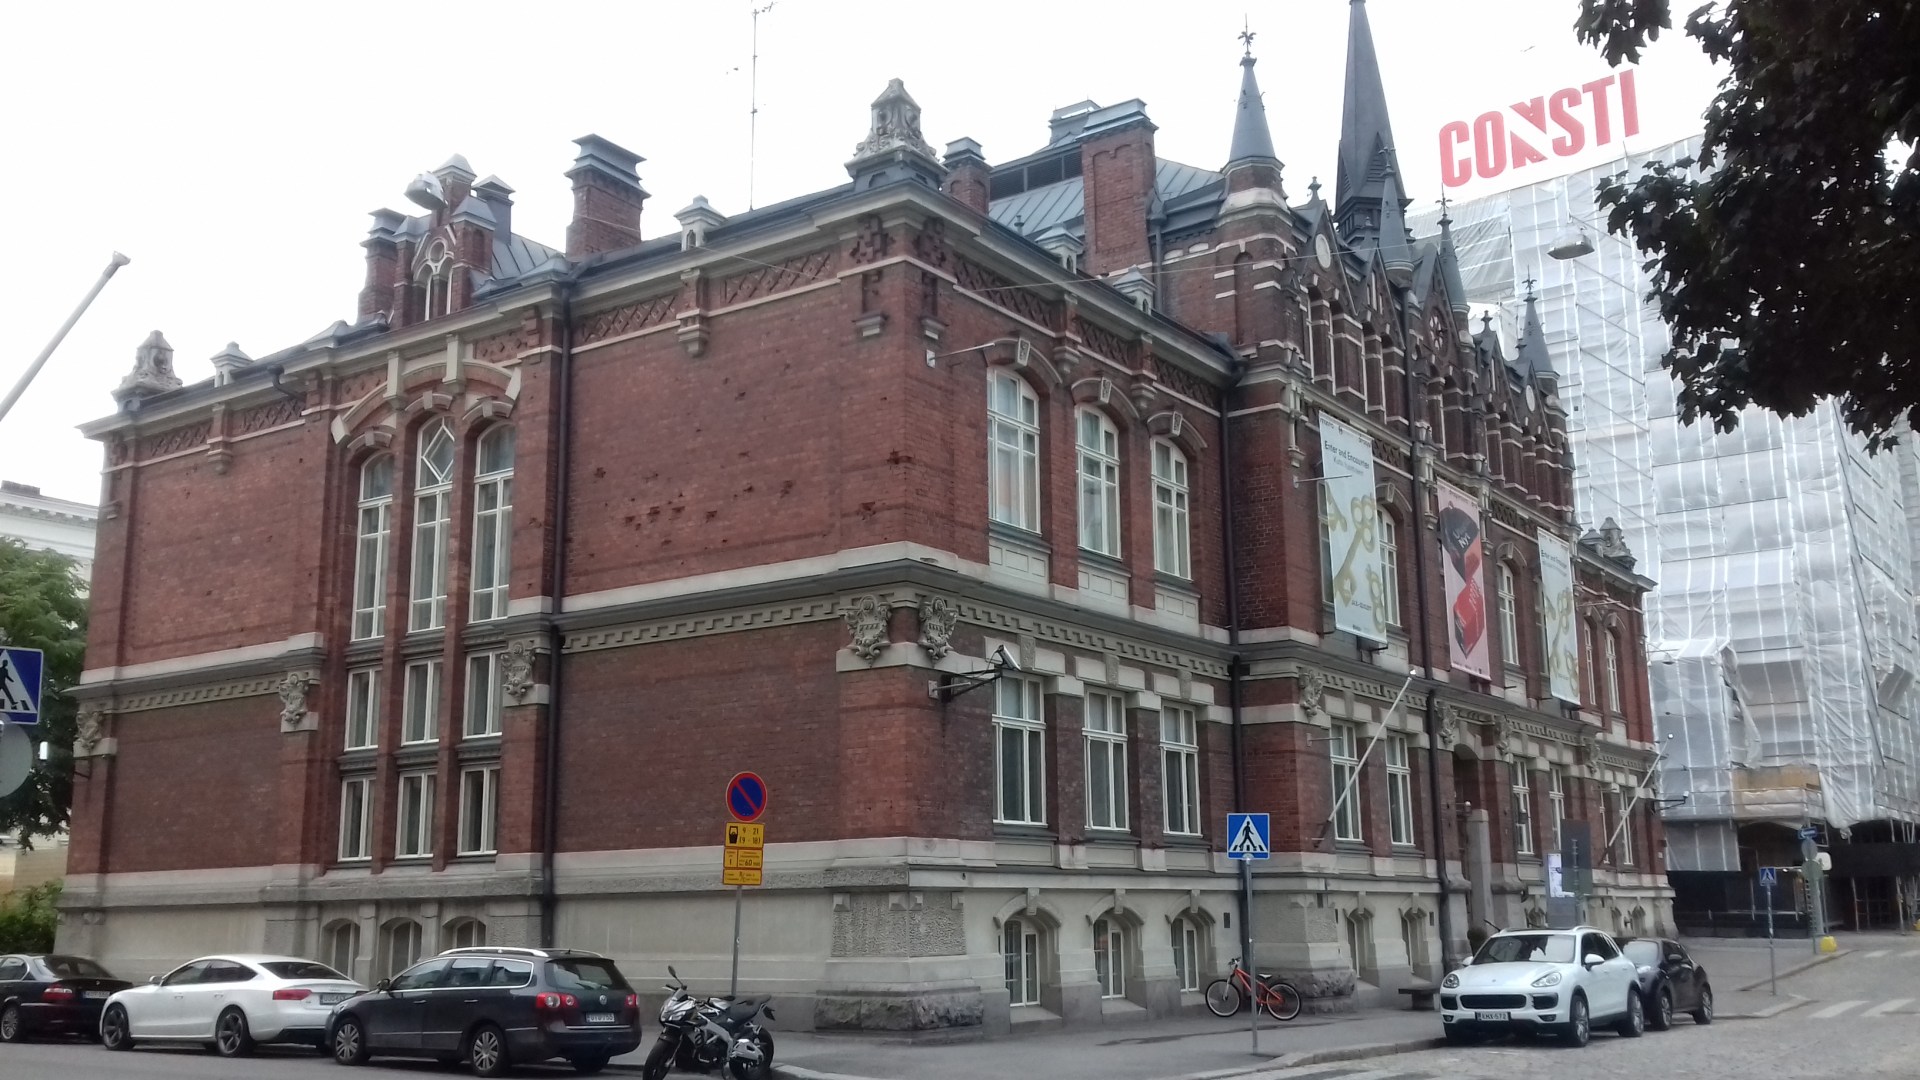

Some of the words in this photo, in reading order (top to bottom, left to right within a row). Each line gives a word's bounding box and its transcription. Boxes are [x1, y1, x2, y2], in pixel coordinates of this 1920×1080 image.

[1439, 68, 1640, 188] CONSTI
[1325, 440, 1338, 454] Enter
[1339, 448, 1347, 459] and
[1347, 451, 1370, 470] Encounter
[744, 859, 753, 867] 60
